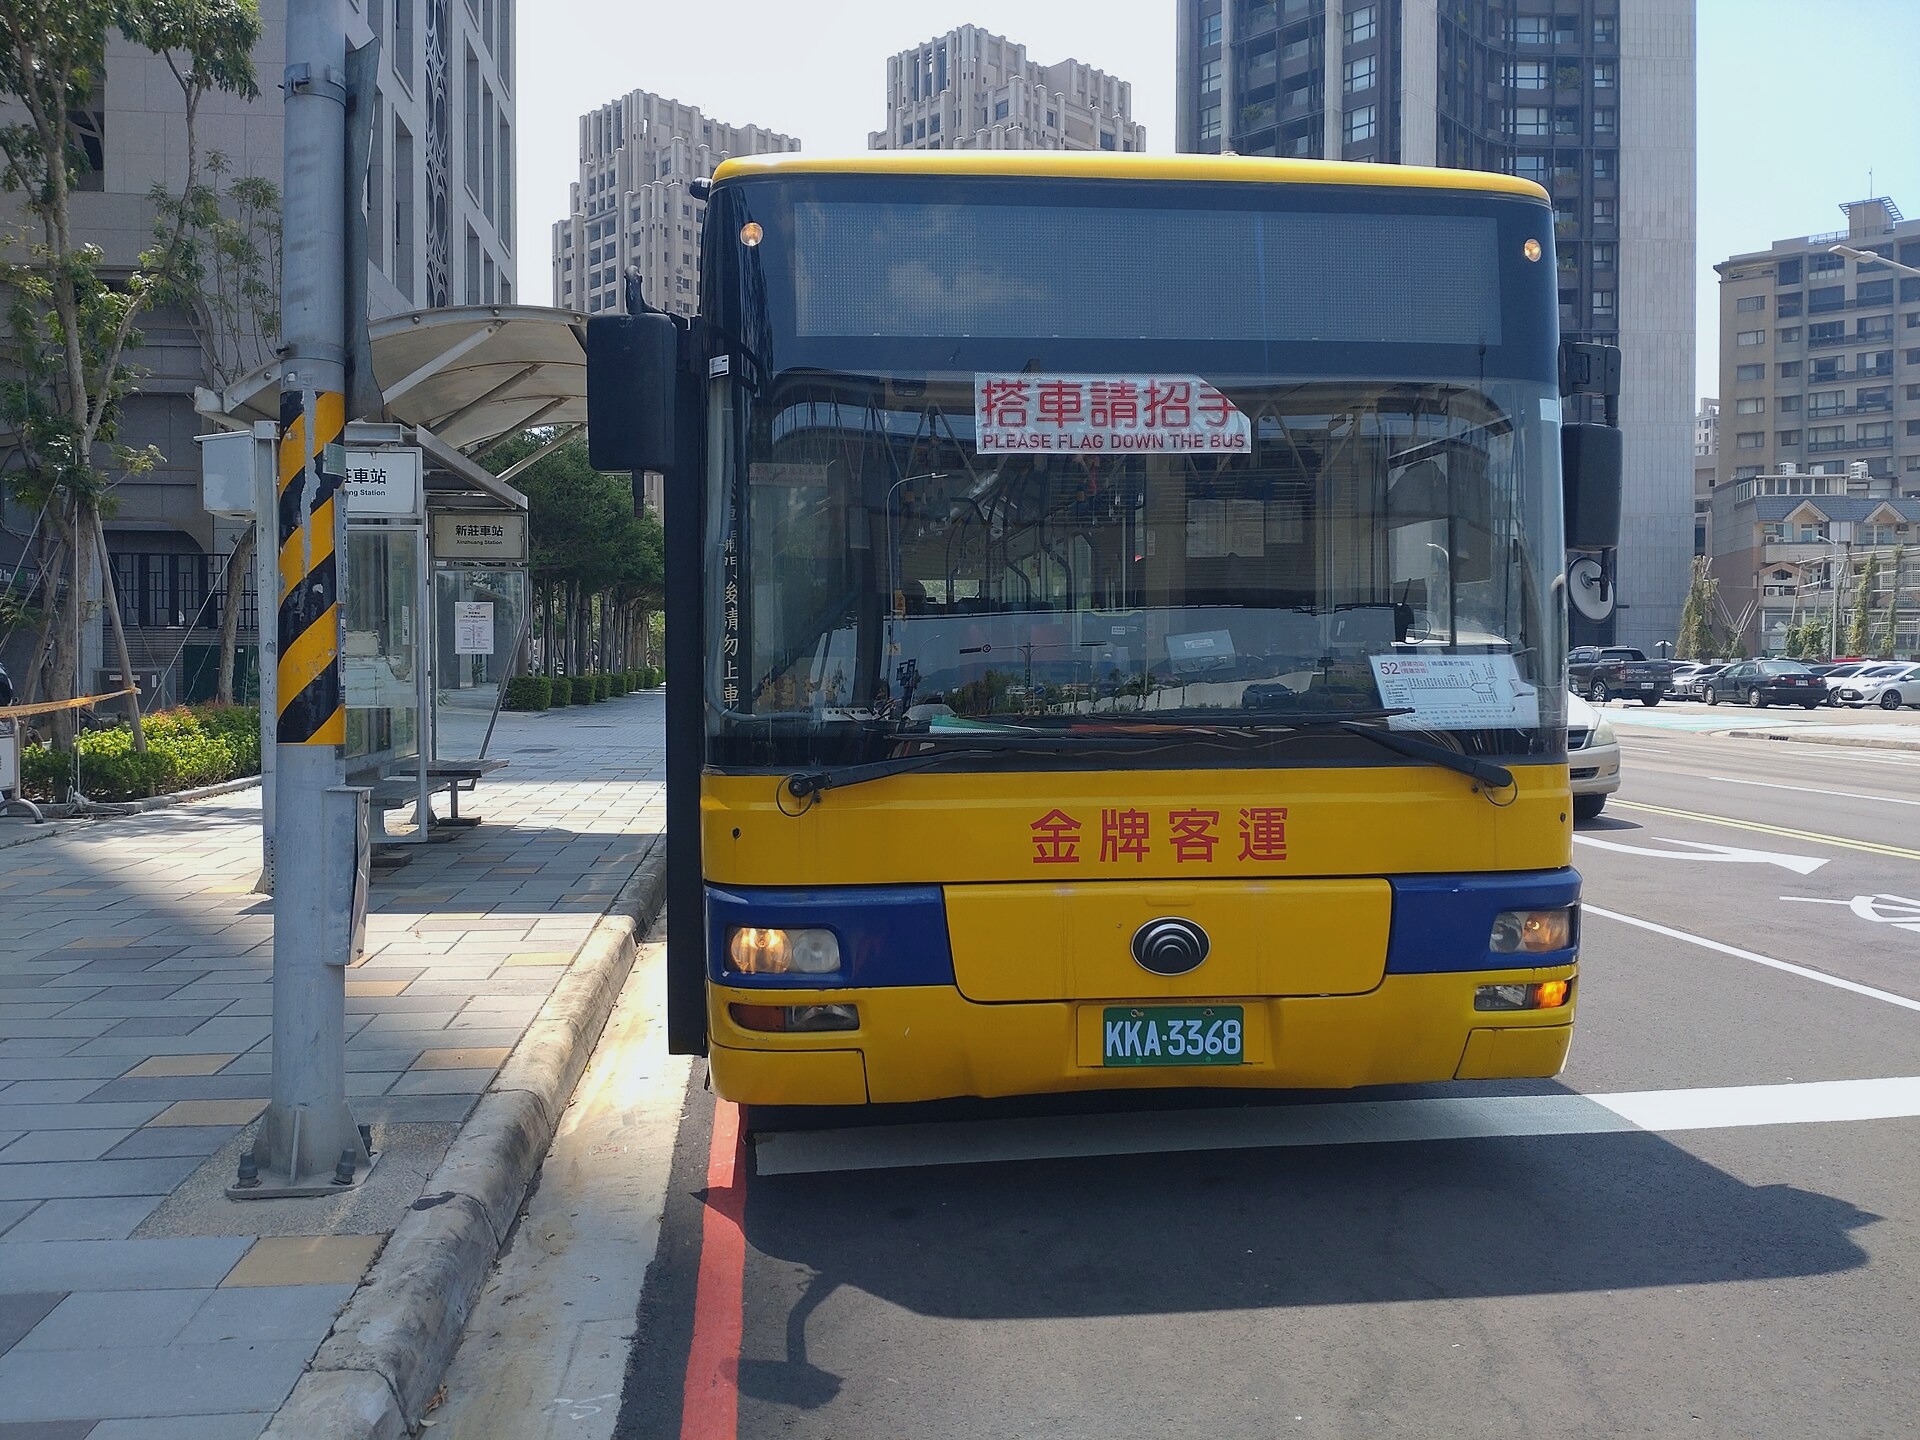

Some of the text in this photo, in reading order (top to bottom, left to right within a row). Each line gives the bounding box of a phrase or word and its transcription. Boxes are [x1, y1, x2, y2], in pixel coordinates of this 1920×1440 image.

[981, 379, 1239, 428] 搭車請招手
[983, 433, 1245, 449] PLEASE FLAG DOWN THE BUS
[360, 488, 386, 496] Station
[455, 525, 504, 537] 新莊車站
[1380, 662, 1401, 675] 52
[1030, 807, 1288, 863] 金牌客運
